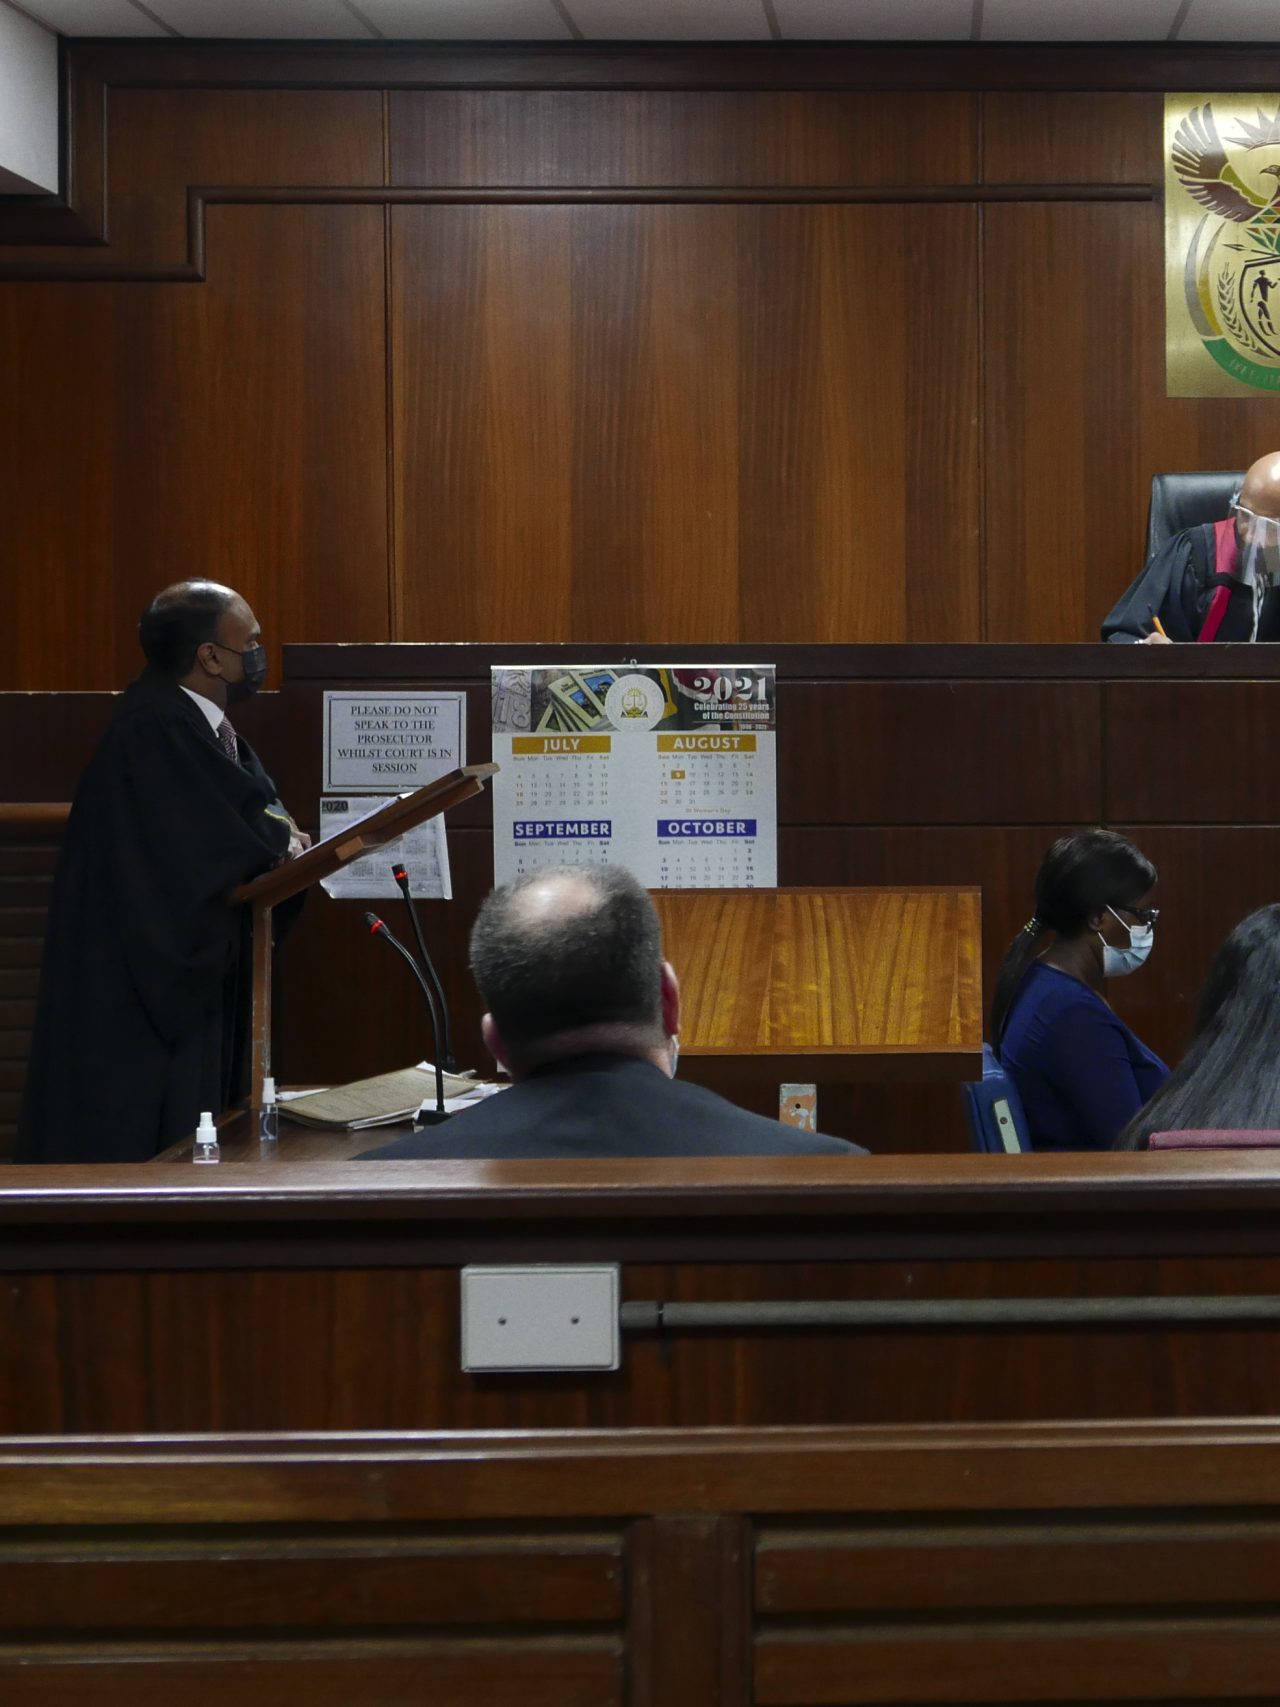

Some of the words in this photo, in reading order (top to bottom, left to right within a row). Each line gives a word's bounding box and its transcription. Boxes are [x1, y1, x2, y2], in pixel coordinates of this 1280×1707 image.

[694, 676, 766, 701] 2021
[350, 706, 392, 716] PLEASE
[394, 706, 411, 716] DO
[414, 706, 440, 715] NOT
[694, 703, 738, 712] Celebrating
[748, 704, 770, 712] years
[702, 712, 710, 720] of
[711, 712, 724, 720] the
[724, 712, 770, 720] Constitution
[354, 720, 390, 730] SPEAK
[392, 720, 409, 730] TO
[410, 720, 436, 730] THE
[357, 734, 432, 744] PROSECUTOR
[673, 737, 741, 750] AUGUST
[544, 738, 580, 752] JULY
[338, 749, 384, 758] WHILST
[385, 749, 425, 758] COURT
[427, 749, 438, 758] IS
[440, 748, 452, 758] IN
[372, 763, 418, 772] SESSION
[515, 823, 610, 836] SEPTEMBER
[668, 822, 746, 834] OCTOBER
